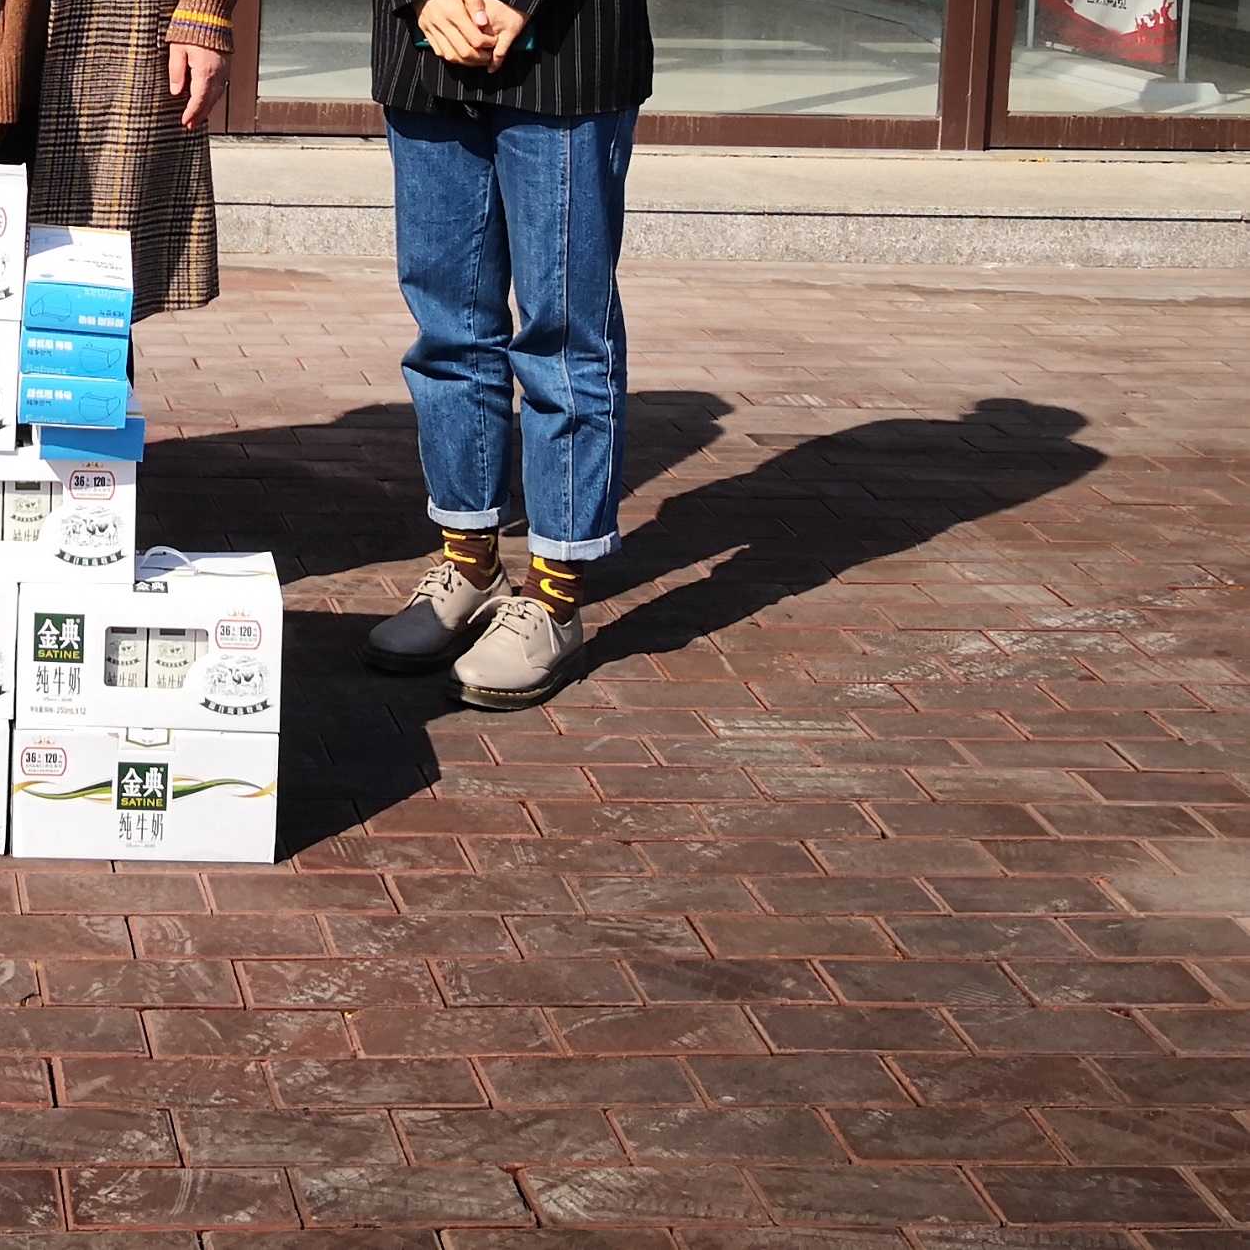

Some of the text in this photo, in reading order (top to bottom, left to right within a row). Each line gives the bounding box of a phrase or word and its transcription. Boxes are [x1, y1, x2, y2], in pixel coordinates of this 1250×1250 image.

[93, 476, 106, 487] 120
[38, 618, 81, 650] 金典
[239, 625, 252, 637] 120
[37, 649, 80, 659] SATINE
[36, 665, 81, 695] 纯牛奶
[45, 752, 58, 763] 120
[121, 767, 164, 798] 金典
[121, 798, 163, 807] SATINE
[119, 813, 163, 841] 纯牛奶
